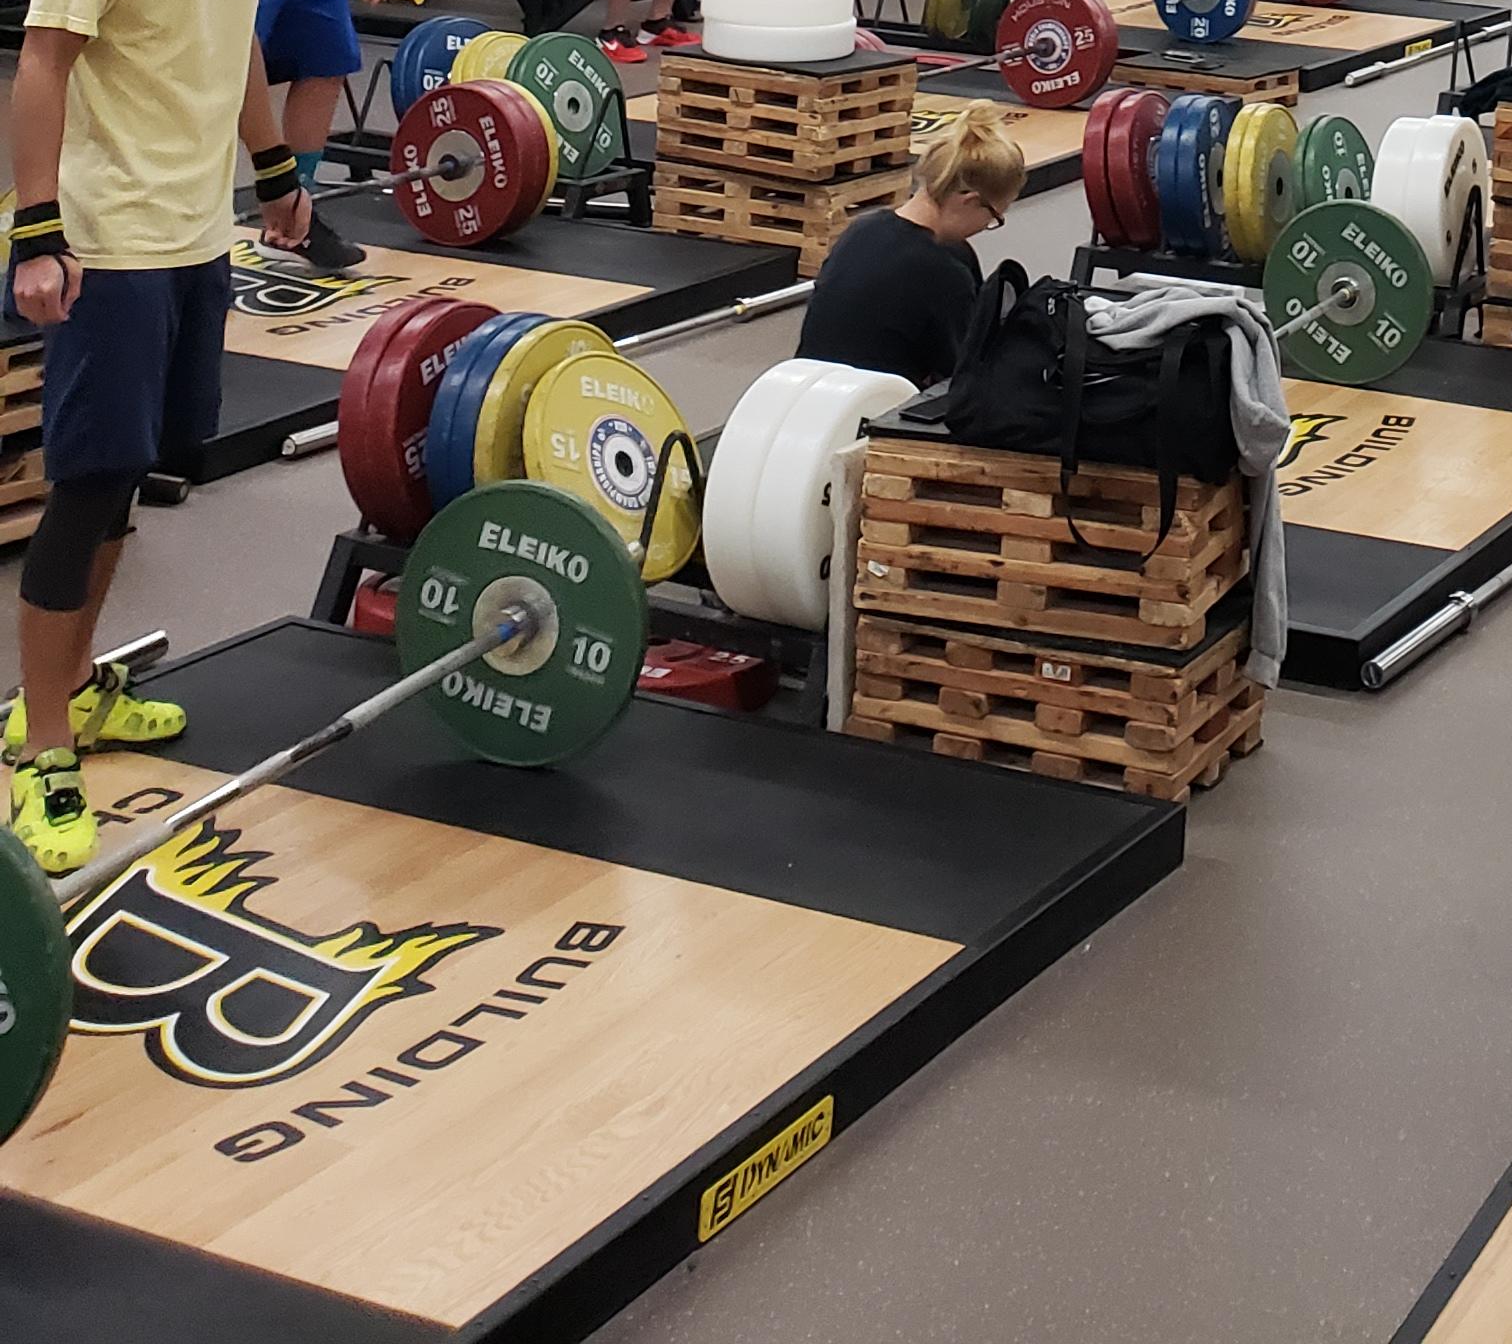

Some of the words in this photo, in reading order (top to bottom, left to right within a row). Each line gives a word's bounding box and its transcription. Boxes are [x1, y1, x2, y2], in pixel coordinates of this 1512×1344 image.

[1074, 29, 1095, 45] 25
[1194, 17, 1207, 38] 20
[535, 63, 554, 87] 10
[568, 49, 609, 99] ELEIK
[1031, 71, 1080, 95] ELEIKO
[432, 96, 451, 128] 25
[478, 115, 508, 189] ELEIKO
[457, 205, 479, 236] 25
[1292, 240, 1318, 269] 10
[1340, 222, 1408, 288] ELEIKO
[1286, 298, 1352, 364] ELEIO
[1376, 319, 1402, 349] 10
[580, 375, 655, 415] ELEIKO
[551, 432, 582, 461] 15
[1278, 415, 1416, 496] BUILDING
[478, 521, 589, 584] ELEIKO
[420, 577, 459, 615] 10
[572, 637, 612, 673] 10
[709, 650, 749, 664] 25
[441, 670, 552, 734] ELEIKO
[214, 921, 626, 1162] BUILDING
[740, 1111, 825, 1199] DYNAMIC
